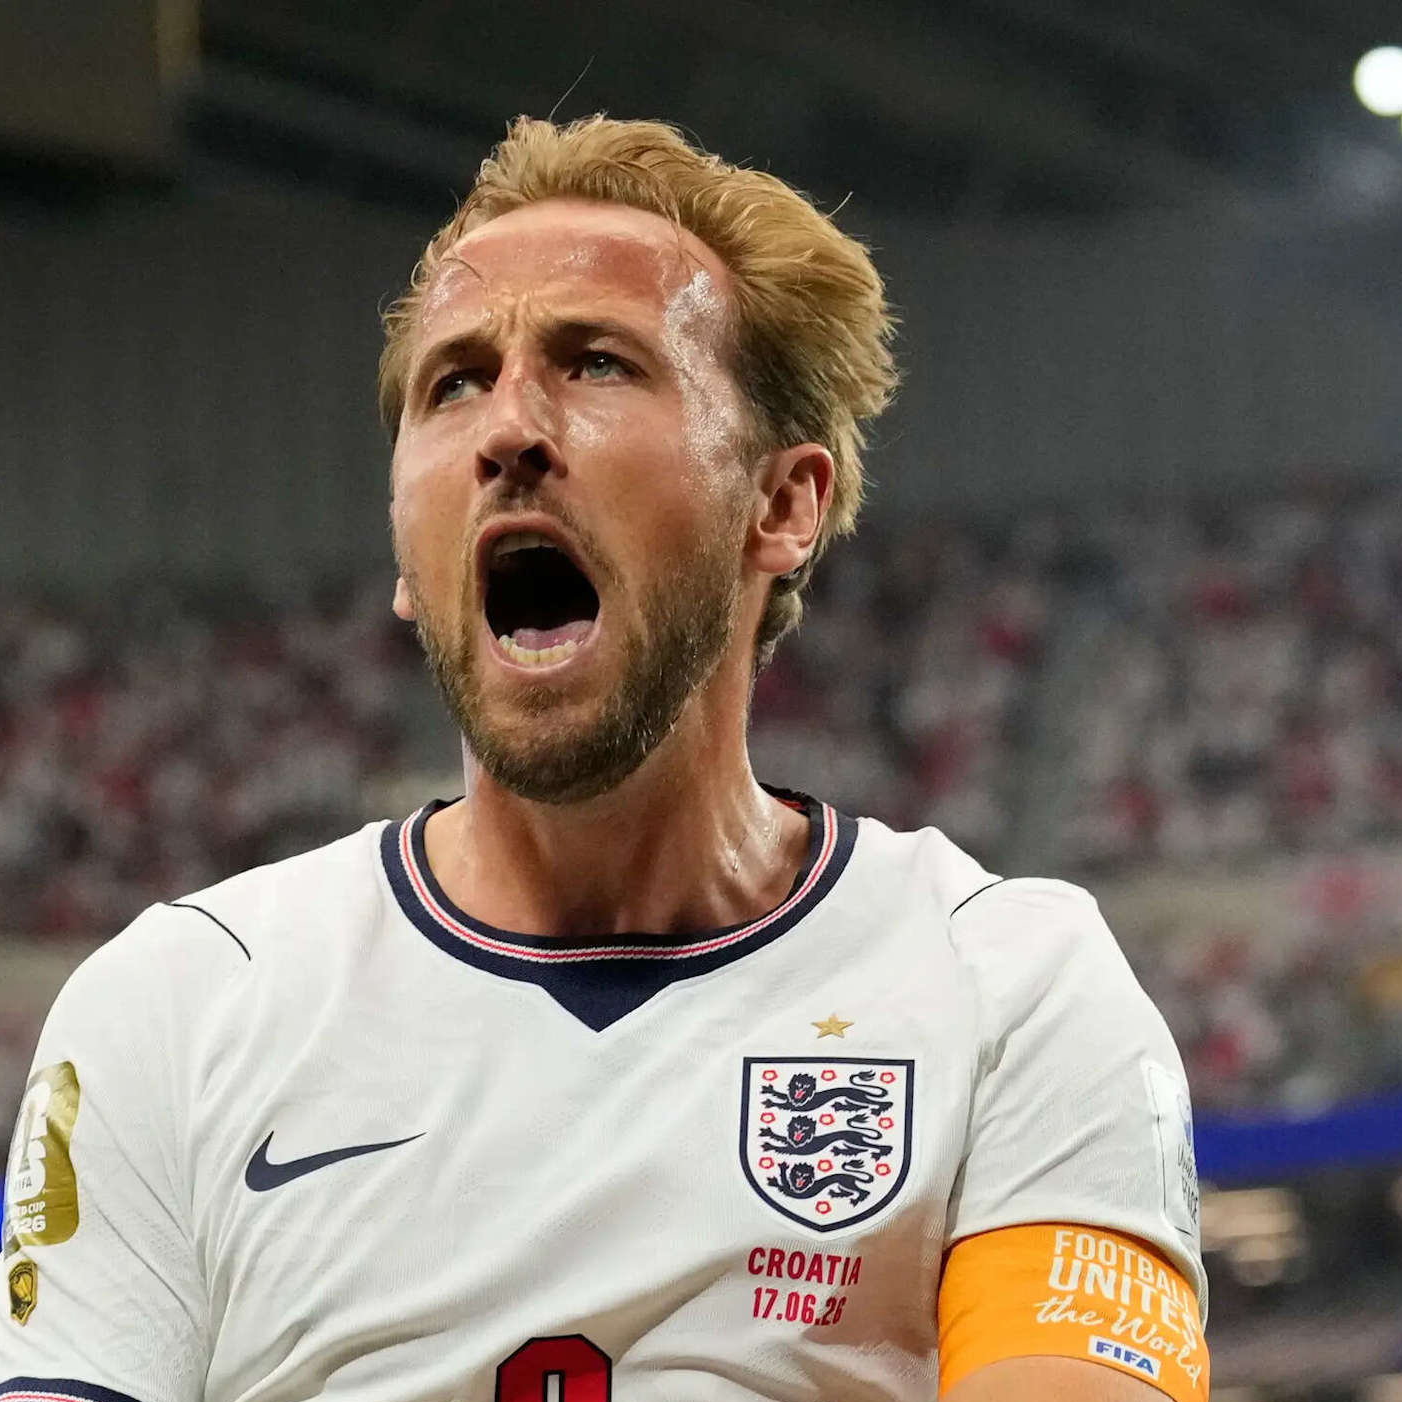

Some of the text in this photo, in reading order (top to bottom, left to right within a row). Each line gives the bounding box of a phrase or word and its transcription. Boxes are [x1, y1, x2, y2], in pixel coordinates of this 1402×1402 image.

[748, 1247, 862, 1286] CROATIA
[1054, 1230, 1190, 1316] FOOTBALL
[752, 1287, 847, 1326] 17.06.26
[1048, 1257, 1198, 1350] UNITES
[1034, 1296, 1203, 1389] the World
[1096, 1341, 1154, 1375] FIFA
